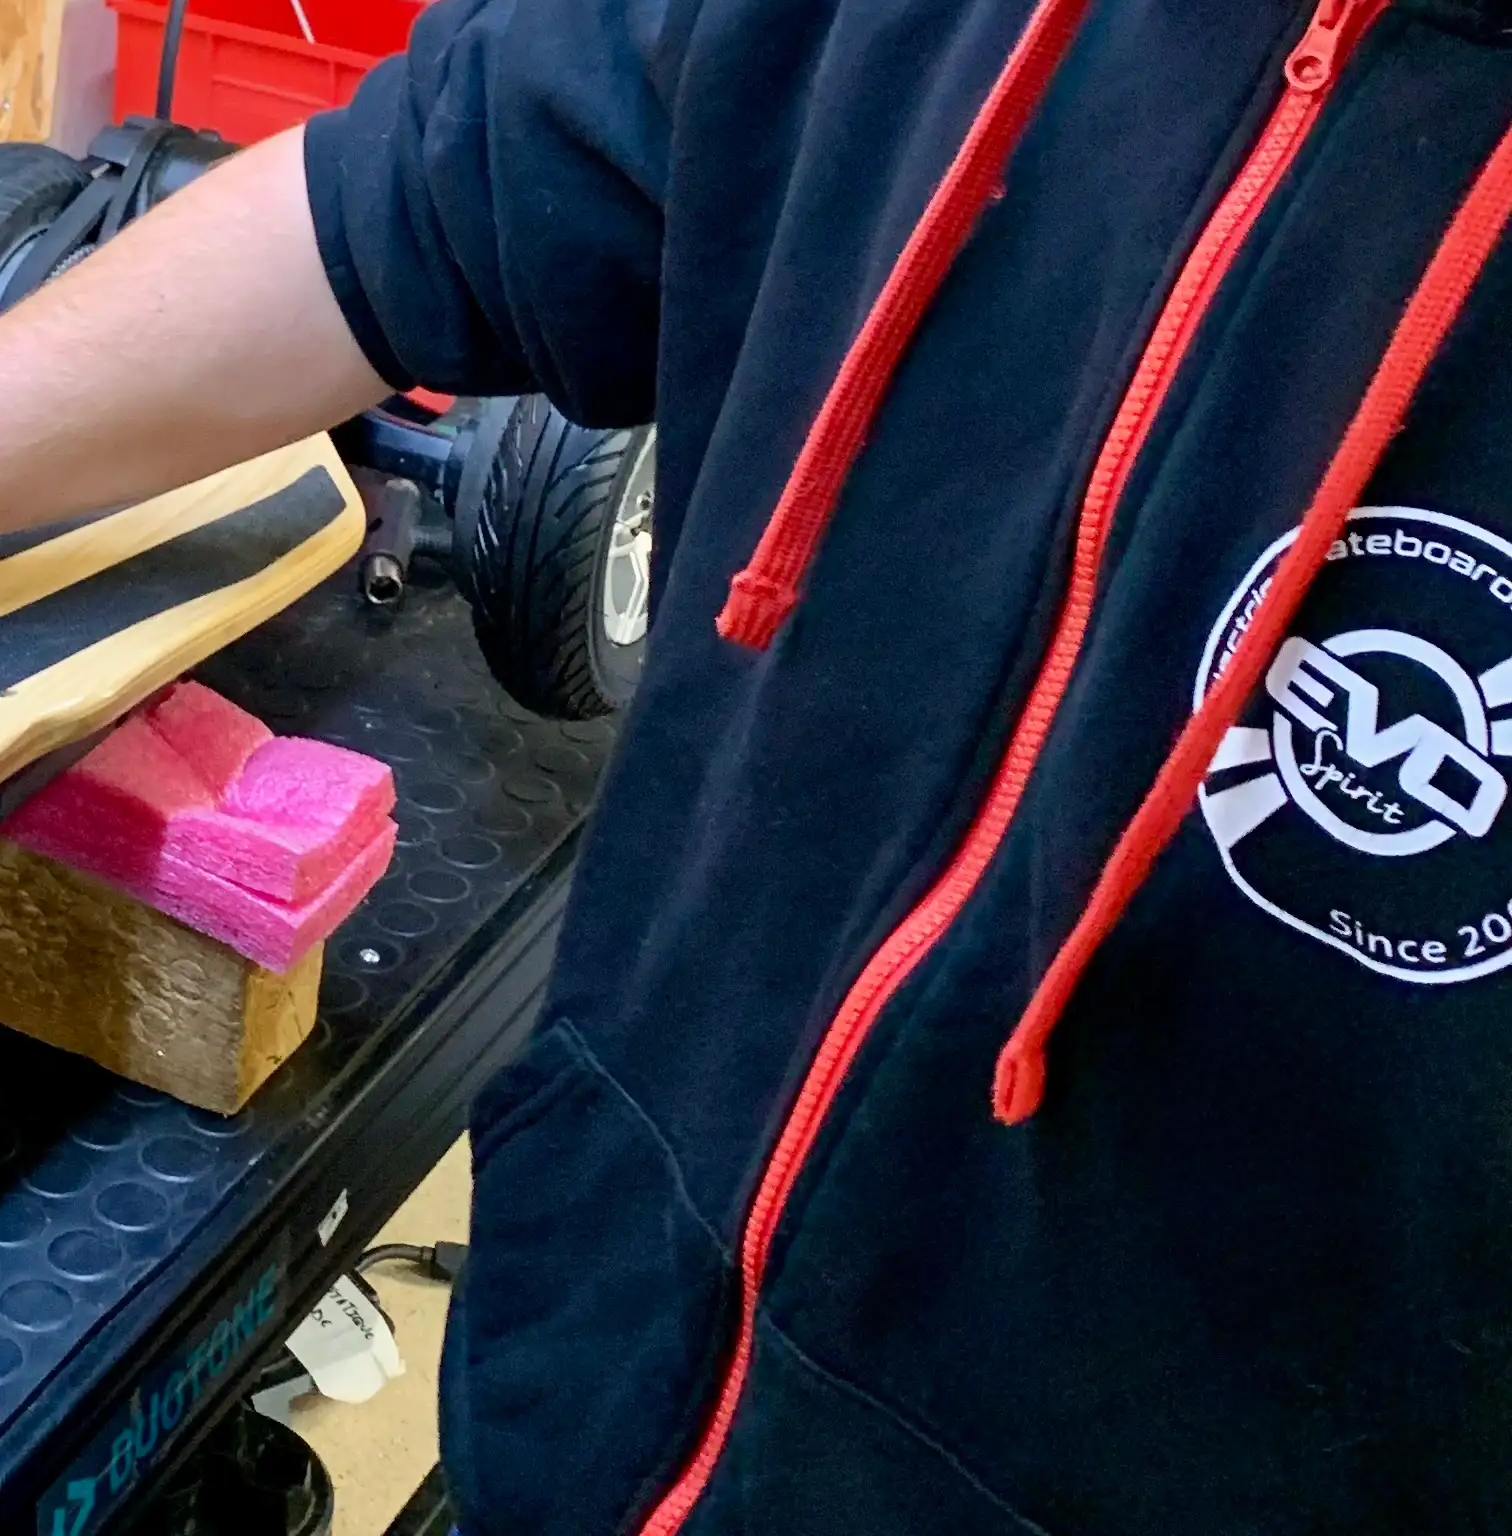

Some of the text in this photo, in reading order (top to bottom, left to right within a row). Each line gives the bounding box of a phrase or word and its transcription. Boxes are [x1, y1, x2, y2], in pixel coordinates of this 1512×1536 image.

[1265, 635, 1508, 838] EVO
[1299, 729, 1405, 825] Spirit
[1329, 897, 1512, 964] Since 20
[108, 1264, 278, 1494] DUOTONE
